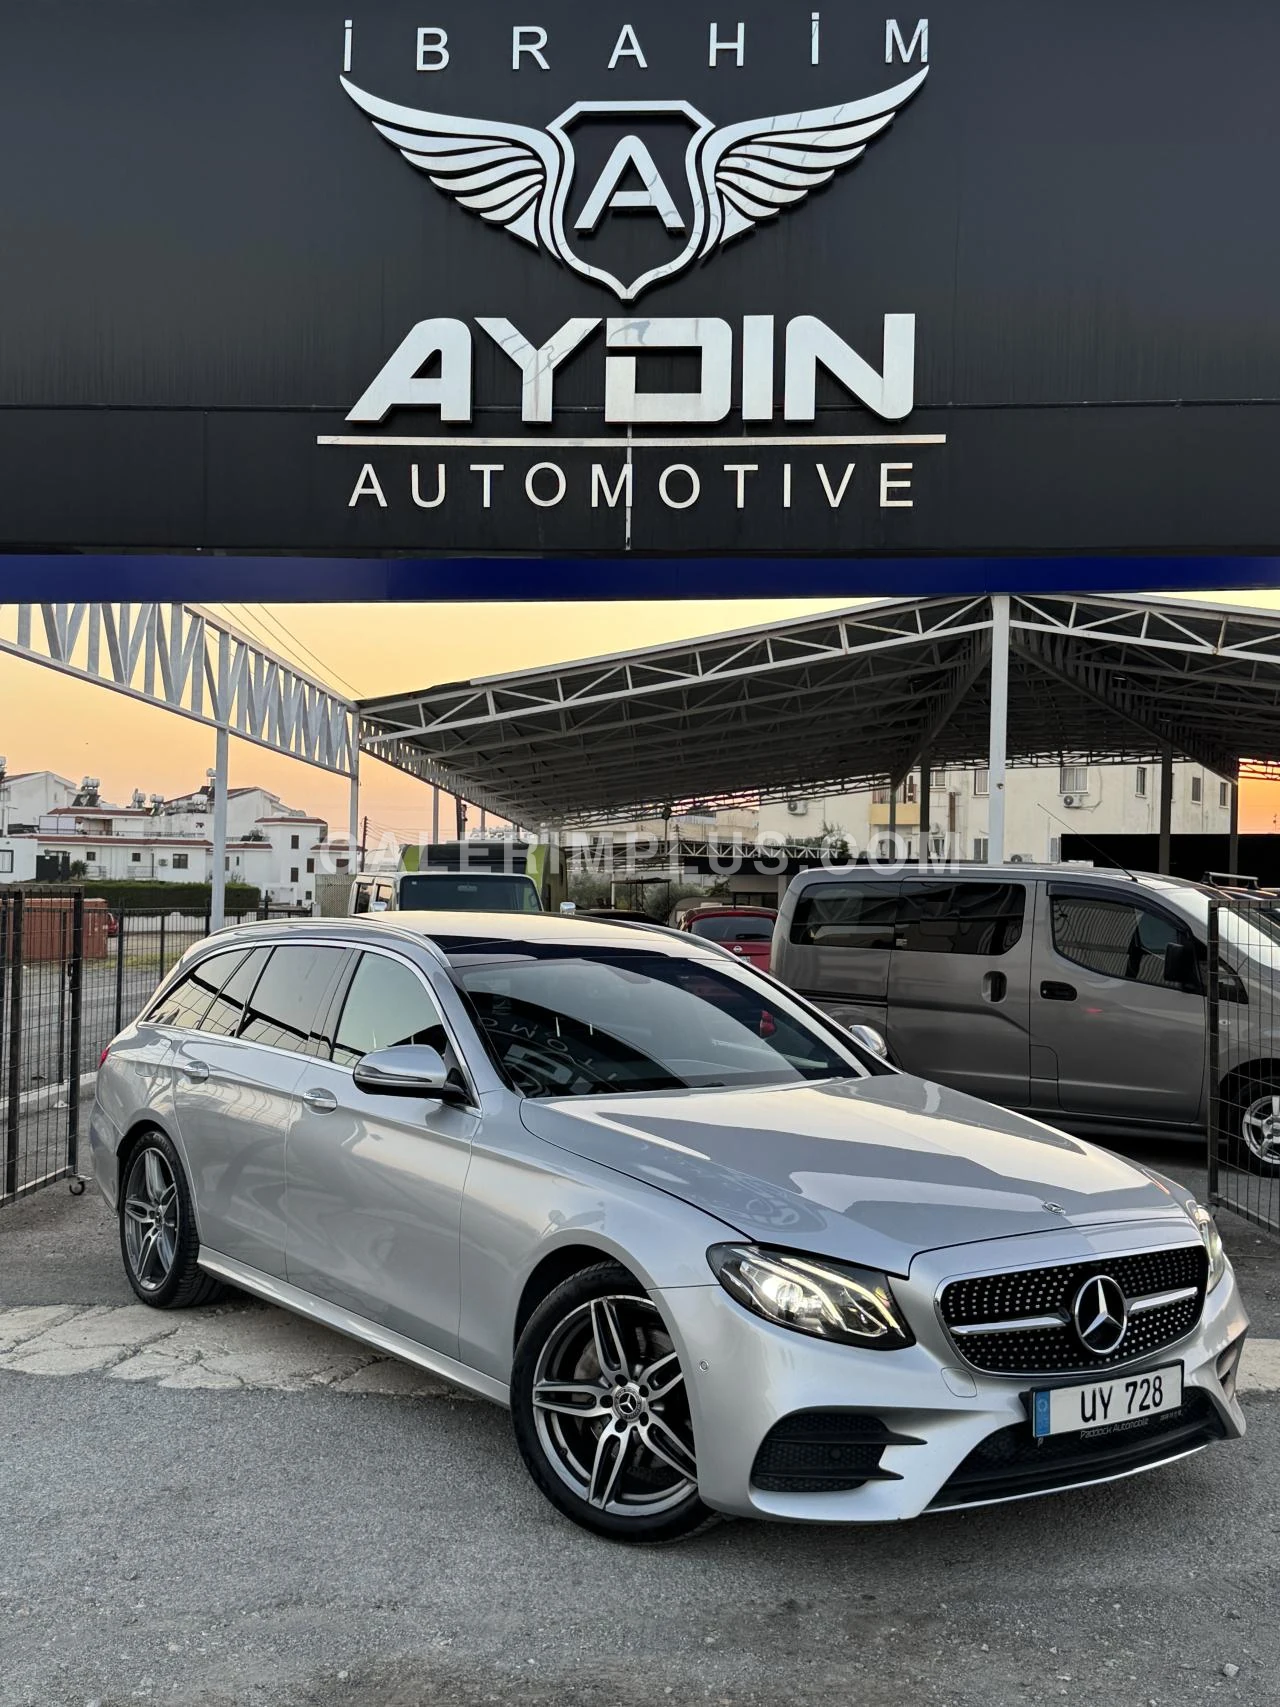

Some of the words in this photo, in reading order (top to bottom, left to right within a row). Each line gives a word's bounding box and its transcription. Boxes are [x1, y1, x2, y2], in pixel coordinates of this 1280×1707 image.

[343, 12, 930, 72] İBRAHİM
[573, 134, 686, 231] A
[344, 313, 916, 423] AYDIN
[348, 461, 914, 509] AUTOMOTIVE
[1081, 1385, 1114, 1423] UY
[1125, 1375, 1163, 1415] 728
